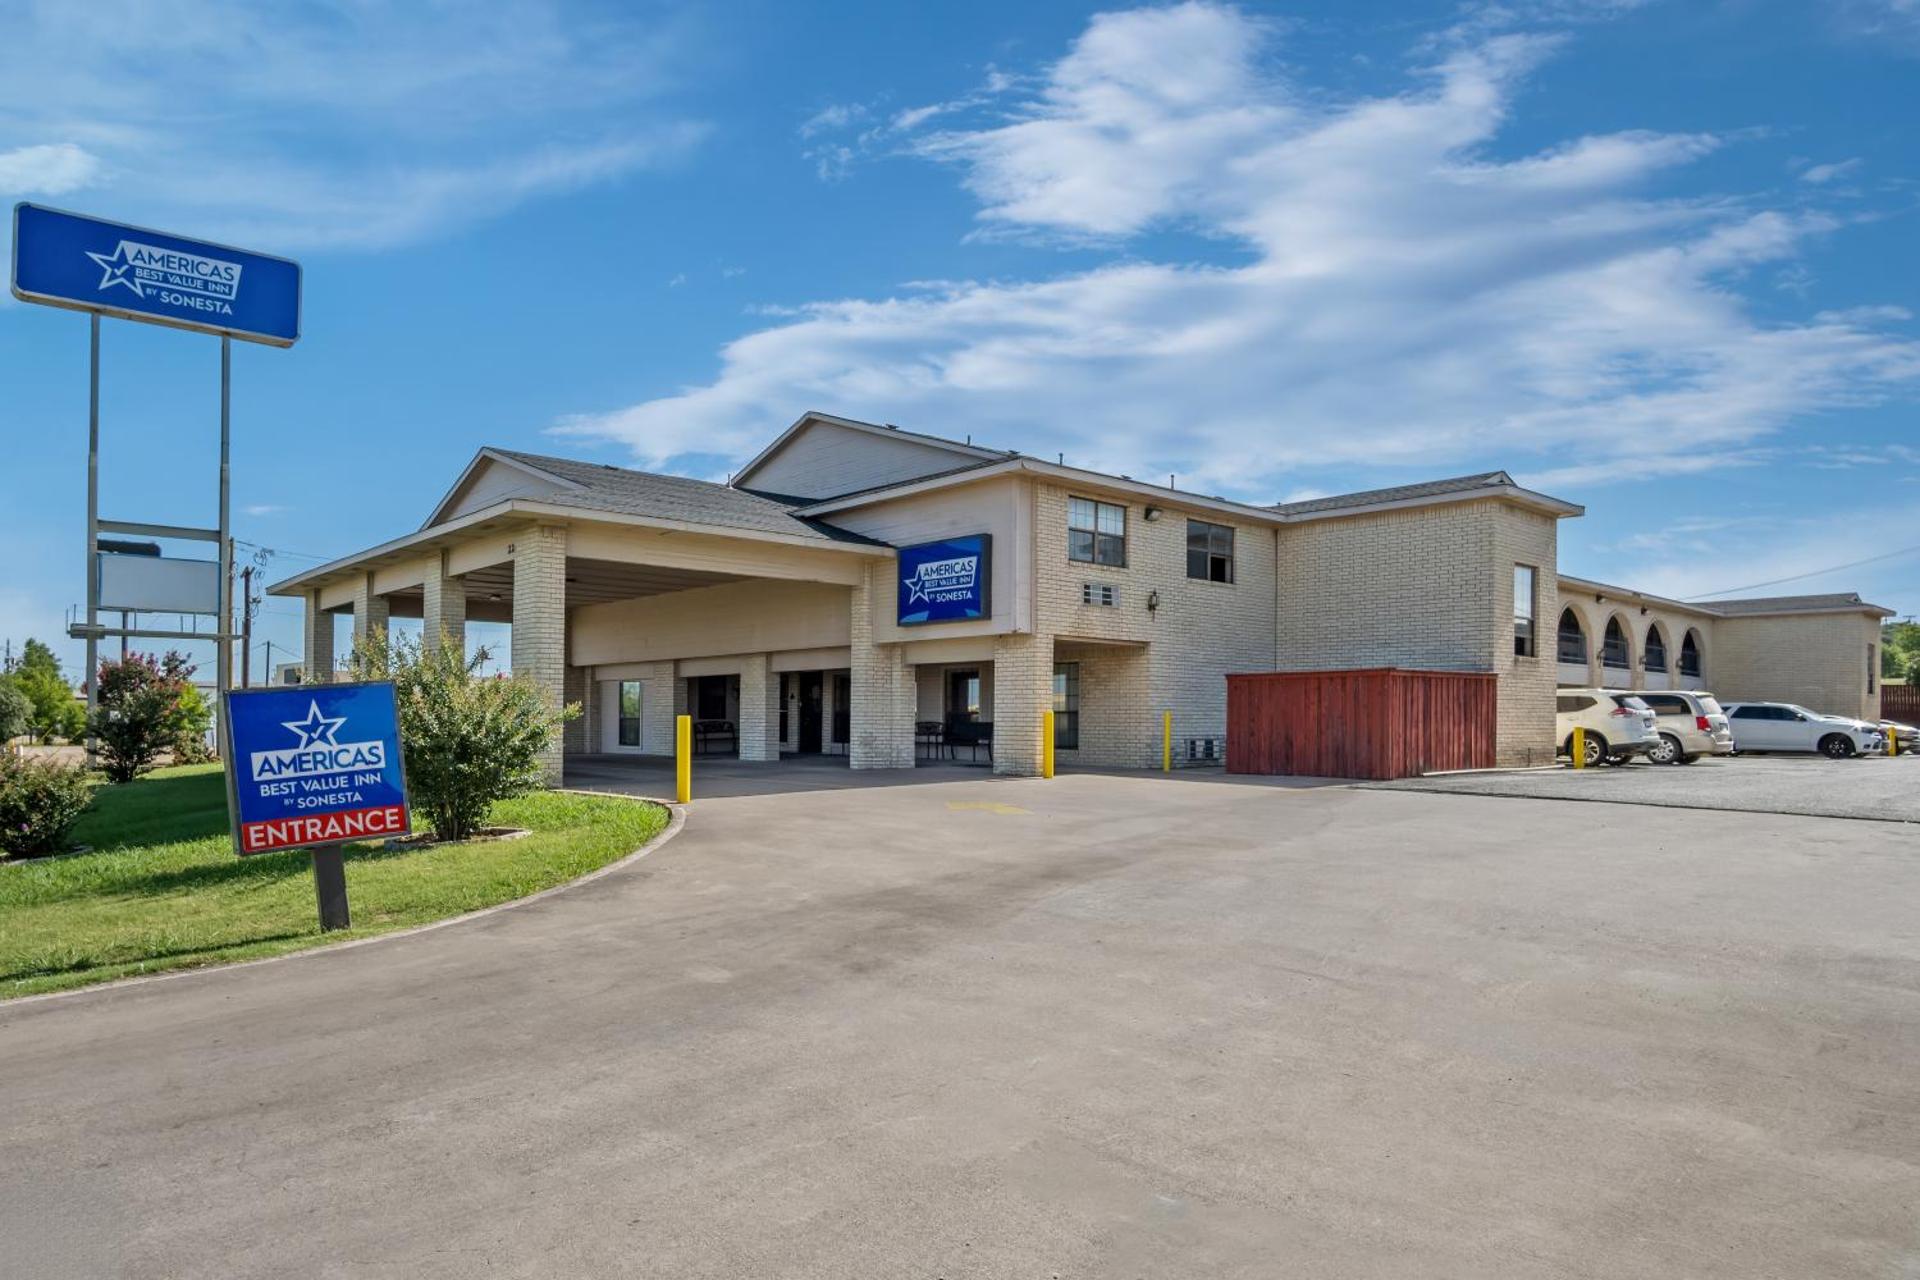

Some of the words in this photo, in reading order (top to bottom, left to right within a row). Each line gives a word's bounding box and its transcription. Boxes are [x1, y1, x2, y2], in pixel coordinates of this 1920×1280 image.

[131, 249, 234, 281] AMERICAS
[135, 268, 164, 280] BEST
[167, 274, 204, 289] VALUE
[208, 281, 229, 294] INN
[146, 287, 157, 296] BY
[160, 290, 232, 315] SONESTA
[924, 561, 973, 577] AMERICAS
[924, 580, 938, 588] BEST
[959, 575, 971, 583] INN
[936, 591, 972, 603] SONESTA
[257, 746, 382, 777] AMERICAS
[260, 781, 297, 797] BEST
[301, 775, 349, 791] VALUE
[354, 772, 381, 786] INN
[284, 798, 294, 806] BY
[297, 792, 363, 809] SONESTA
[250, 808, 400, 848] ENTRANCE
